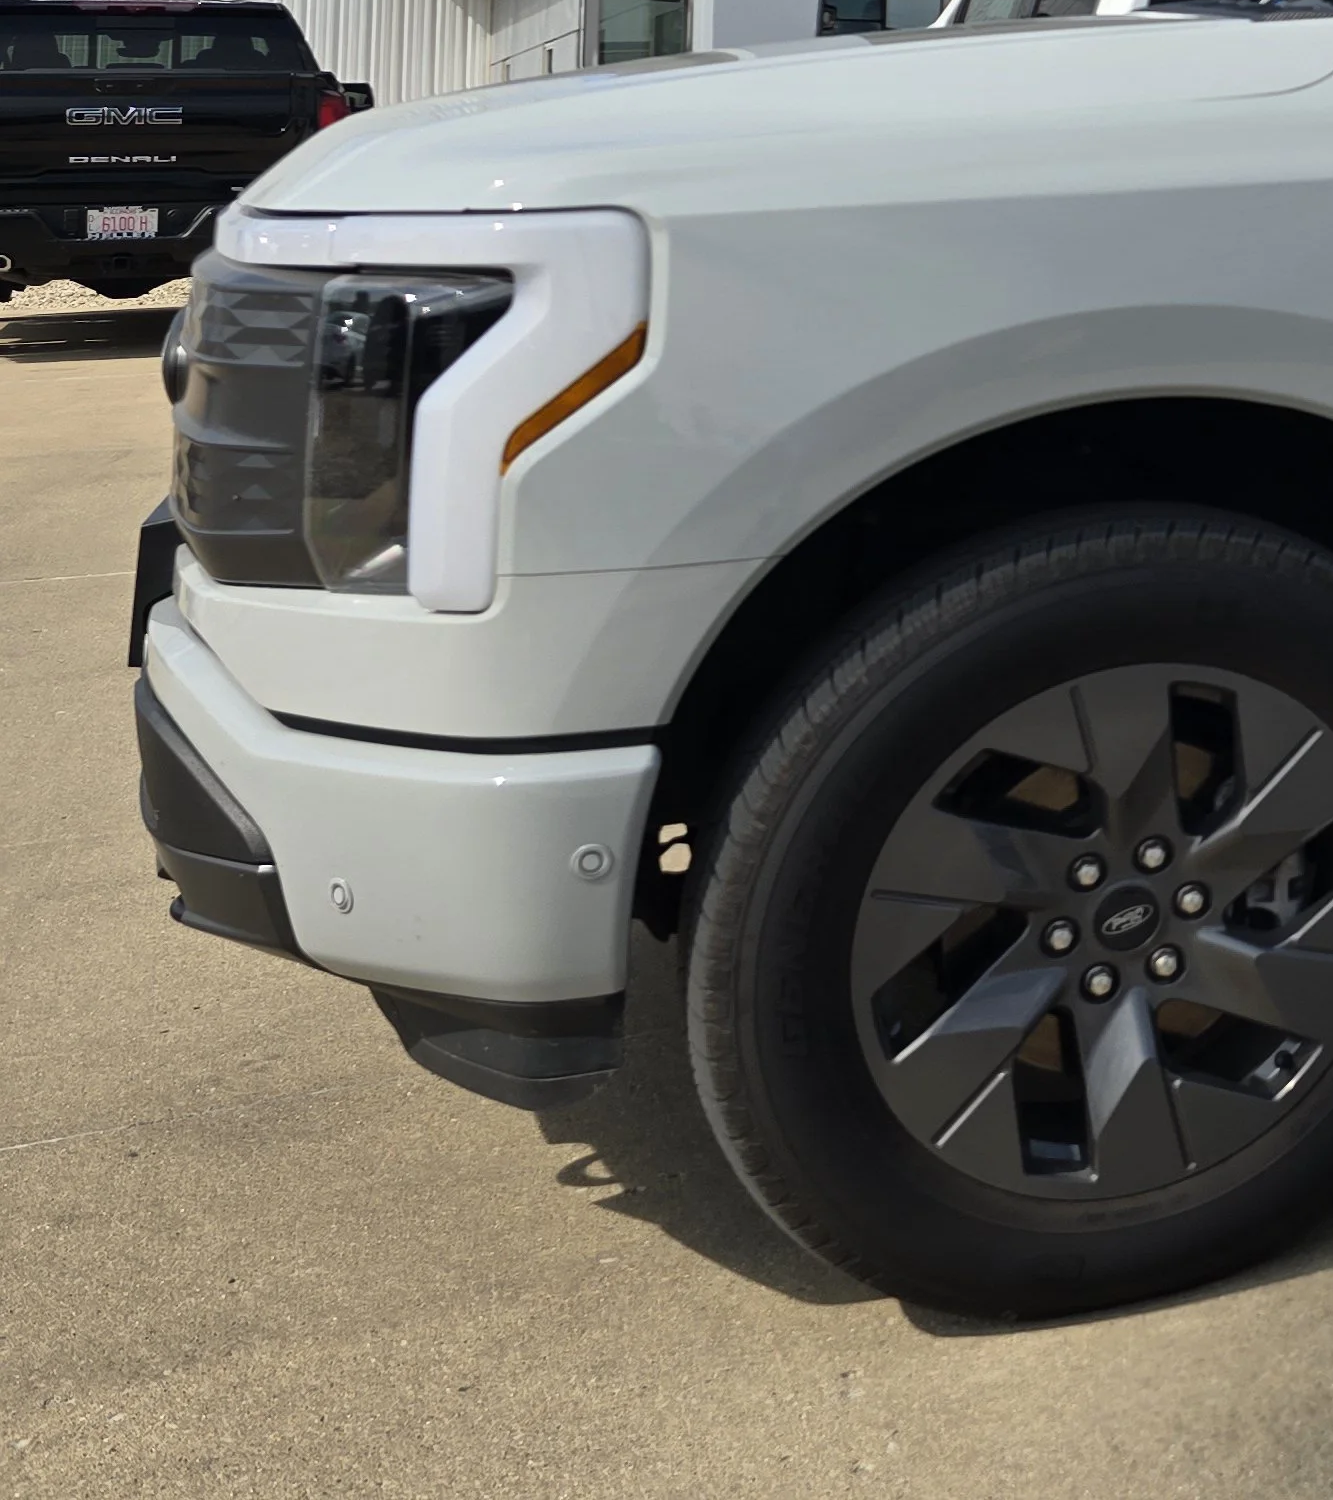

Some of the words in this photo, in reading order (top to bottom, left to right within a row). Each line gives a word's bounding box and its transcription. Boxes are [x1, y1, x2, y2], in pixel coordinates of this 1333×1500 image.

[66, 106, 183, 125] GMC
[69, 155, 177, 163] DENALI
[102, 216, 135, 232] 6100
